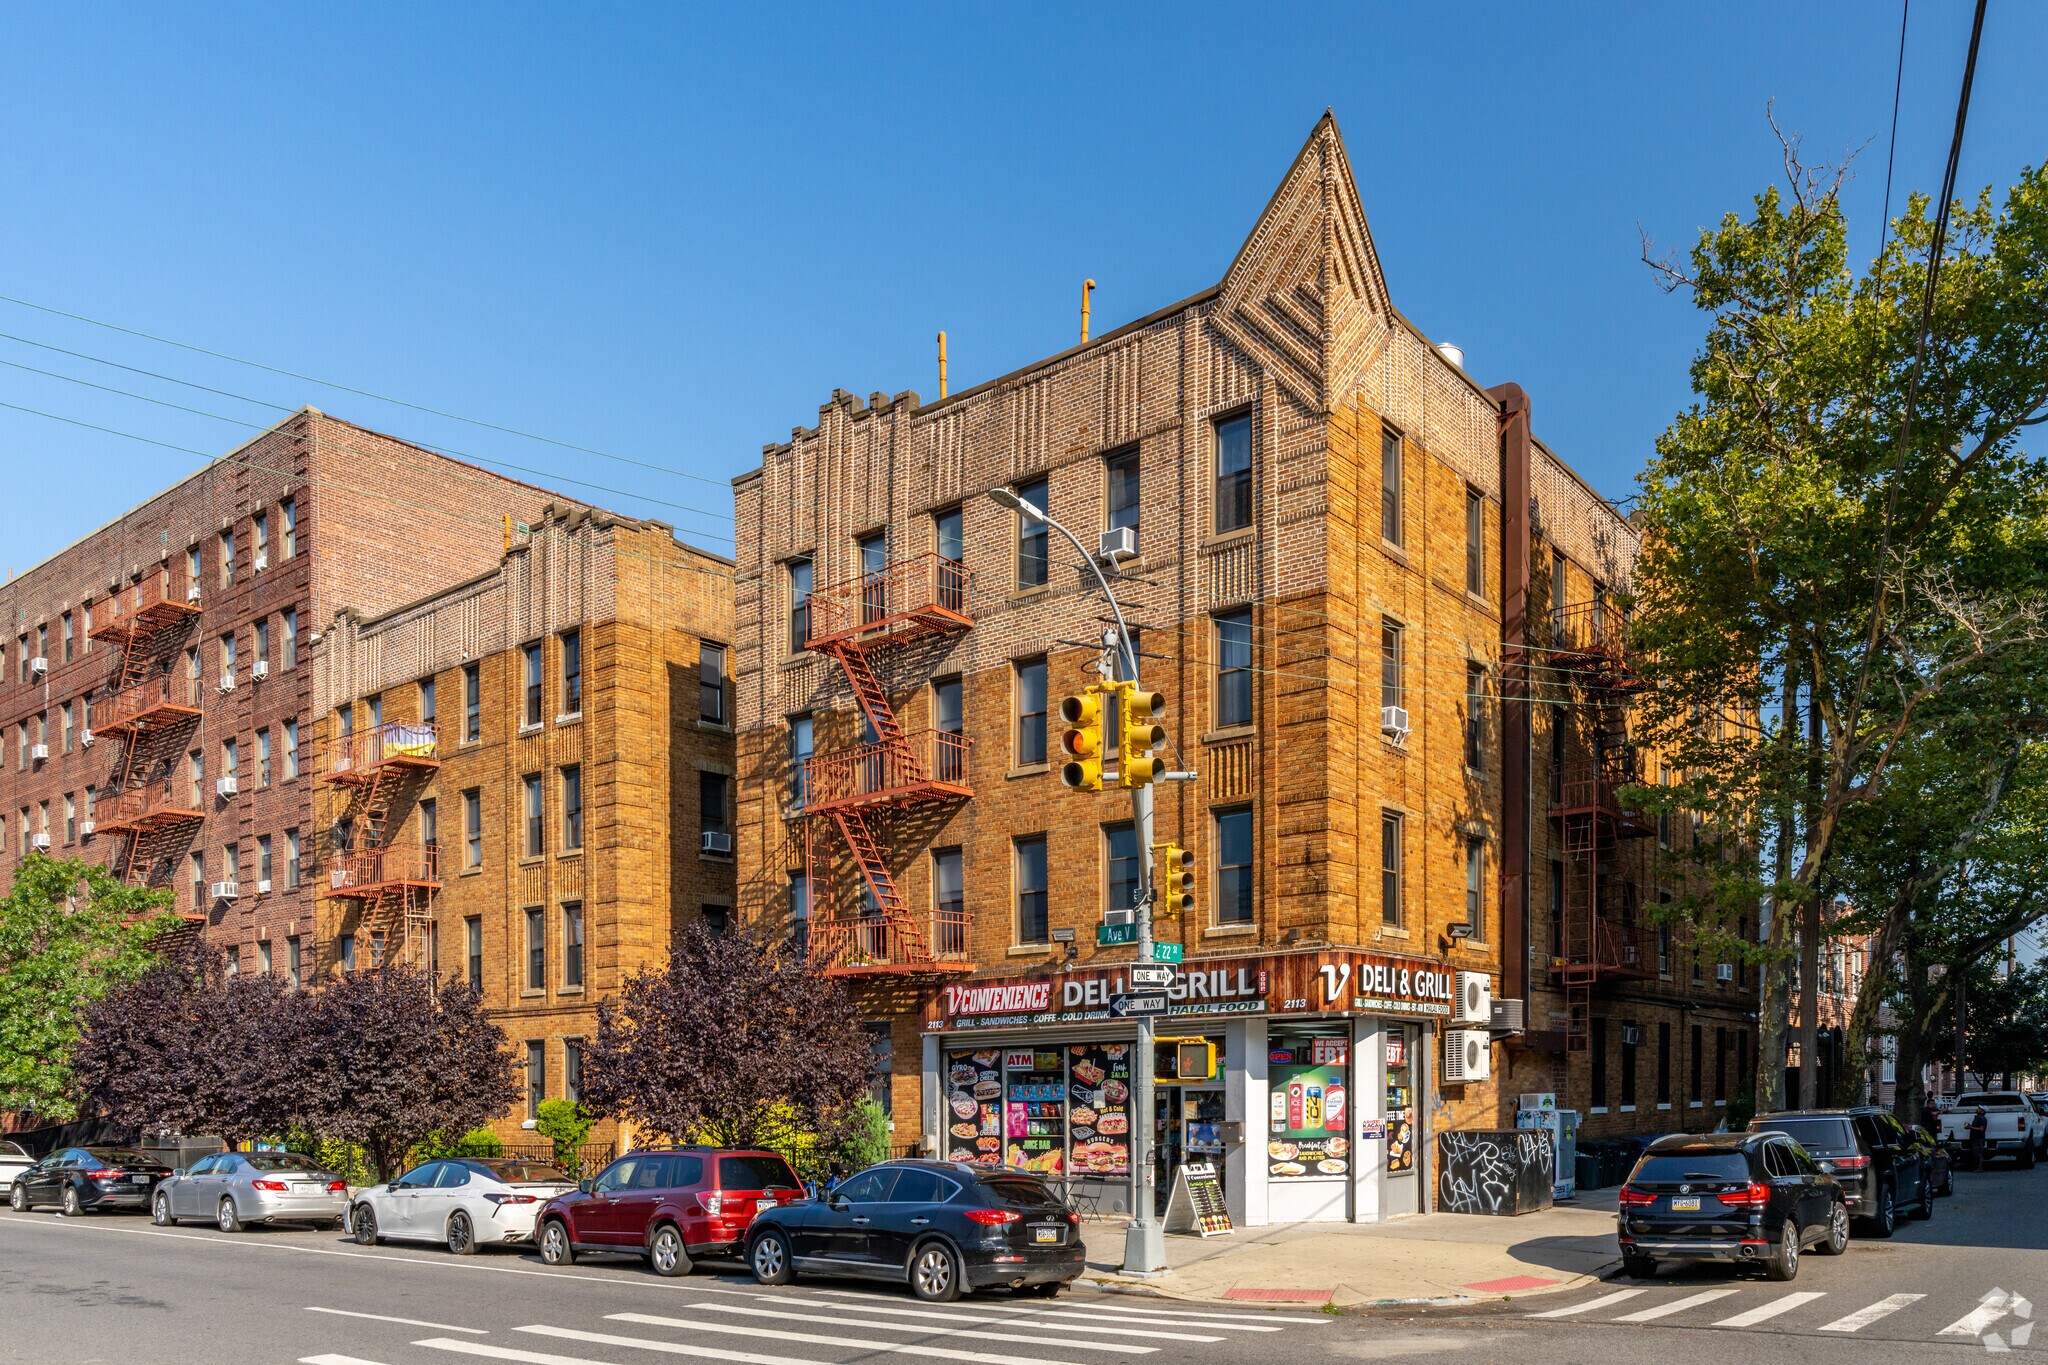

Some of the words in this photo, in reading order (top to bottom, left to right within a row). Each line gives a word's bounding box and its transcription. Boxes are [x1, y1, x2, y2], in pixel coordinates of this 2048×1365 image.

[1107, 928, 1123, 942] Ave
[1124, 926, 1131, 940] V
[1156, 944, 1161, 958] E
[1162, 945, 1171, 960] 22
[1136, 971, 1151, 981] ONE
[1156, 971, 1171, 981] WAY
[1320, 963, 1350, 1001] V
[1363, 964, 1396, 994] DELI
[1400, 968, 1411, 996] &
[1415, 970, 1453, 999] GRILL
[1064, 977, 1123, 1007] DELI
[1168, 967, 1256, 1000] GRILL
[1118, 1001, 1135, 1011] ONE
[1142, 998, 1162, 1009] WAY
[1169, 1003, 1214, 1015] HALAL
[1217, 1001, 1259, 1012] FOOD
[1284, 998, 1306, 1009] 2113
[927, 1020, 944, 1029] 2113
[956, 1018, 975, 1028] GRILL
[980, 1015, 1028, 1026] SANDWICHES
[1033, 1013, 1056, 1024] COFFE
[1062, 1011, 1083, 1022] COLD
[1084, 1010, 1111, 1021] DRINK
[1007, 1054, 1033, 1066] ATM
[1315, 1046, 1348, 1064] EBT
[1386, 1046, 1402, 1064] EBT
[1110, 1071, 1129, 1079] SALAD
[1386, 1110, 1396, 1121] FFEE
[1022, 1140, 1038, 1150] JUICE
[1038, 1140, 1051, 1150] BAR
[1086, 1136, 1115, 1145] BURGERS
